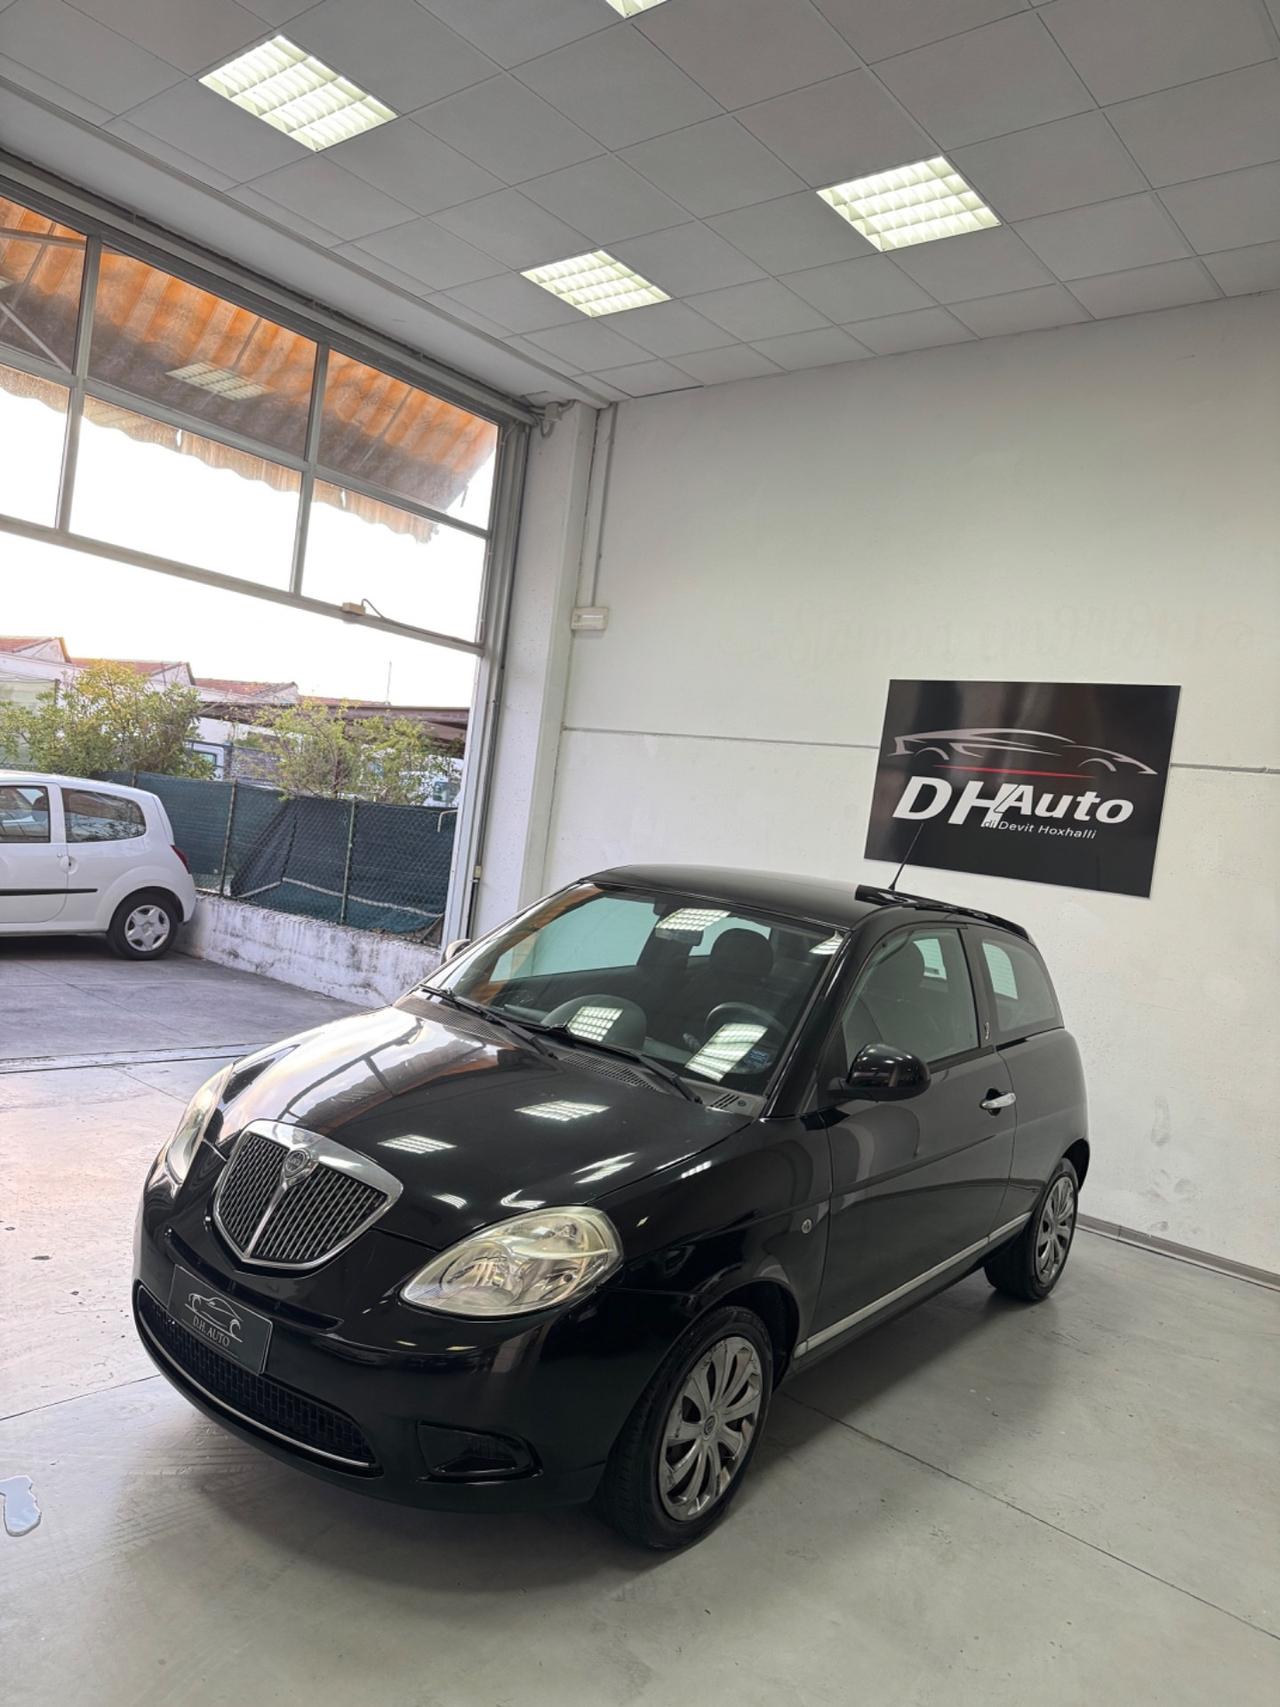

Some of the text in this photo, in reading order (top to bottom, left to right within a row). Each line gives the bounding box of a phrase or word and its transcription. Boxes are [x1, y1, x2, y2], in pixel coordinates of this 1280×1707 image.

[998, 821, 1035, 833] Devit
[1038, 825, 1097, 839] Hoxhalli
[207, 1327, 230, 1347] AUTO
